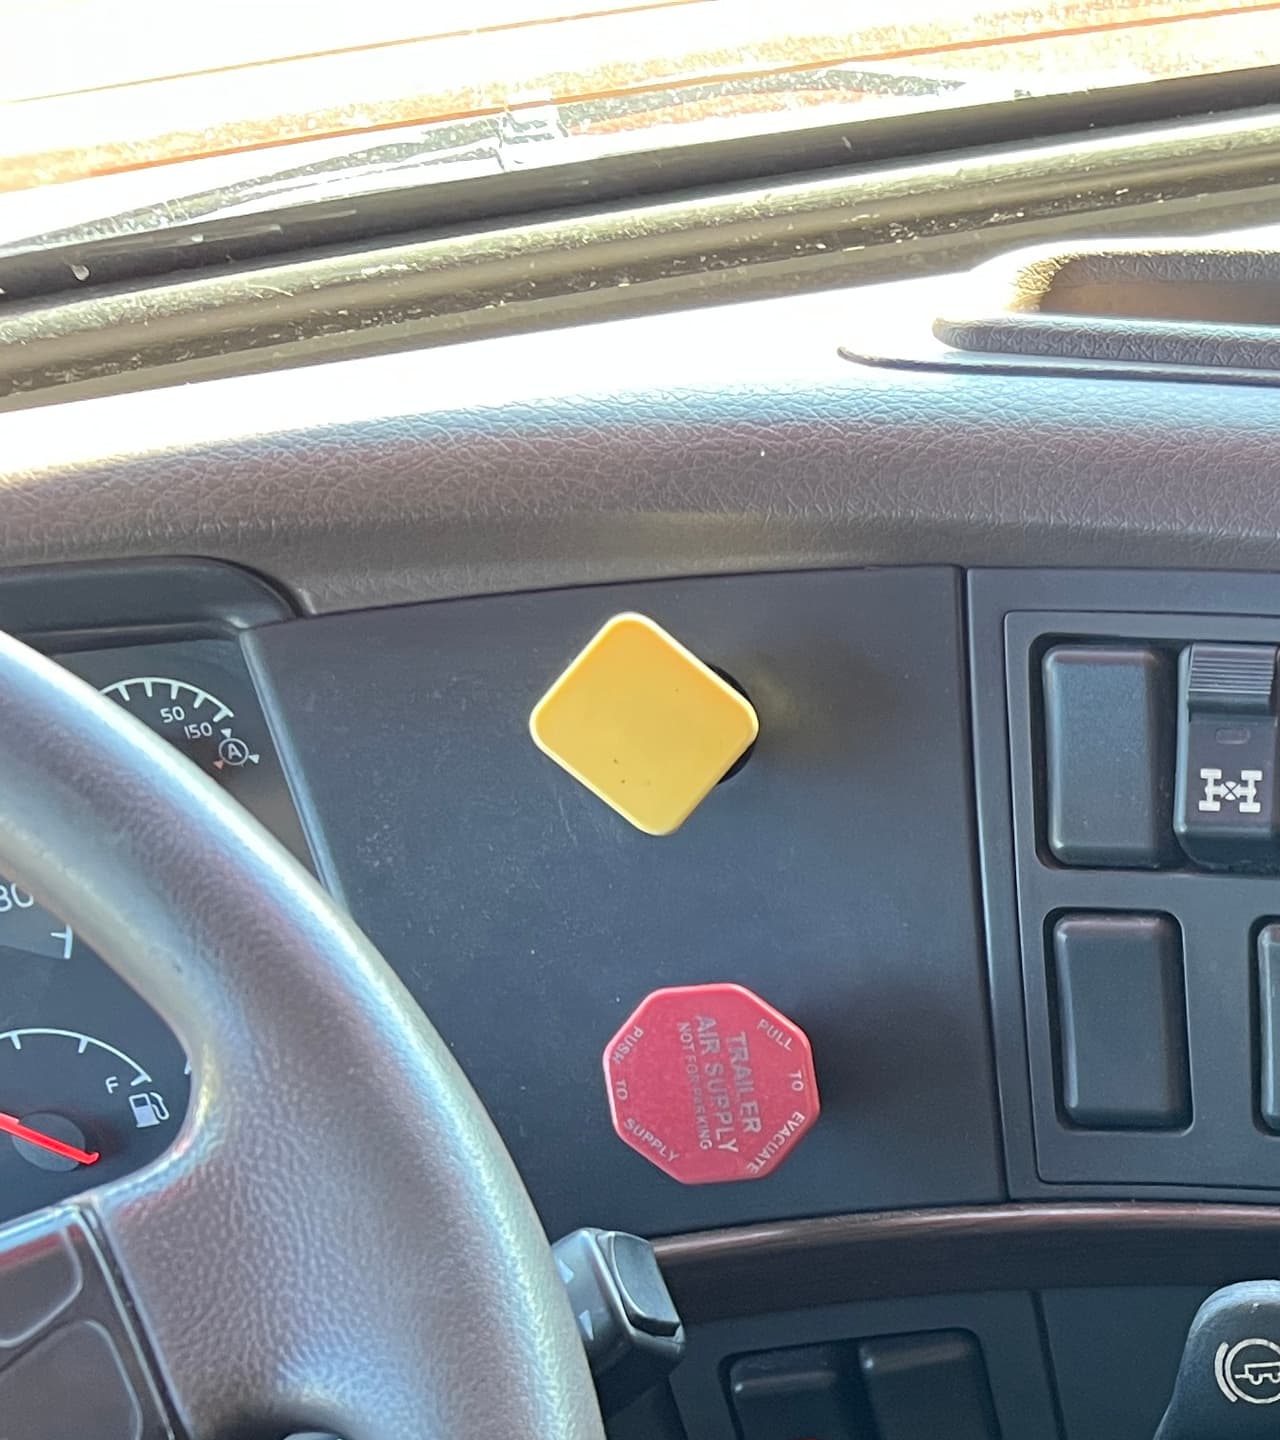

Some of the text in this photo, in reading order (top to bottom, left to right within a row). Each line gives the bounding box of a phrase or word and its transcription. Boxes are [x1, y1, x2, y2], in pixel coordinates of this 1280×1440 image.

[159, 705, 186, 725] 50
[184, 721, 213, 741] 150
[677, 1021, 697, 1053] NOT
[105, 1076, 119, 1094] F
[612, 1026, 680, 1163] PUSH TO SUPPLY
[695, 1015, 740, 1153] AIR SUPPLY
[726, 1030, 762, 1133] TRAILER
[746, 1018, 806, 1175] PULL TO EVACUATE
